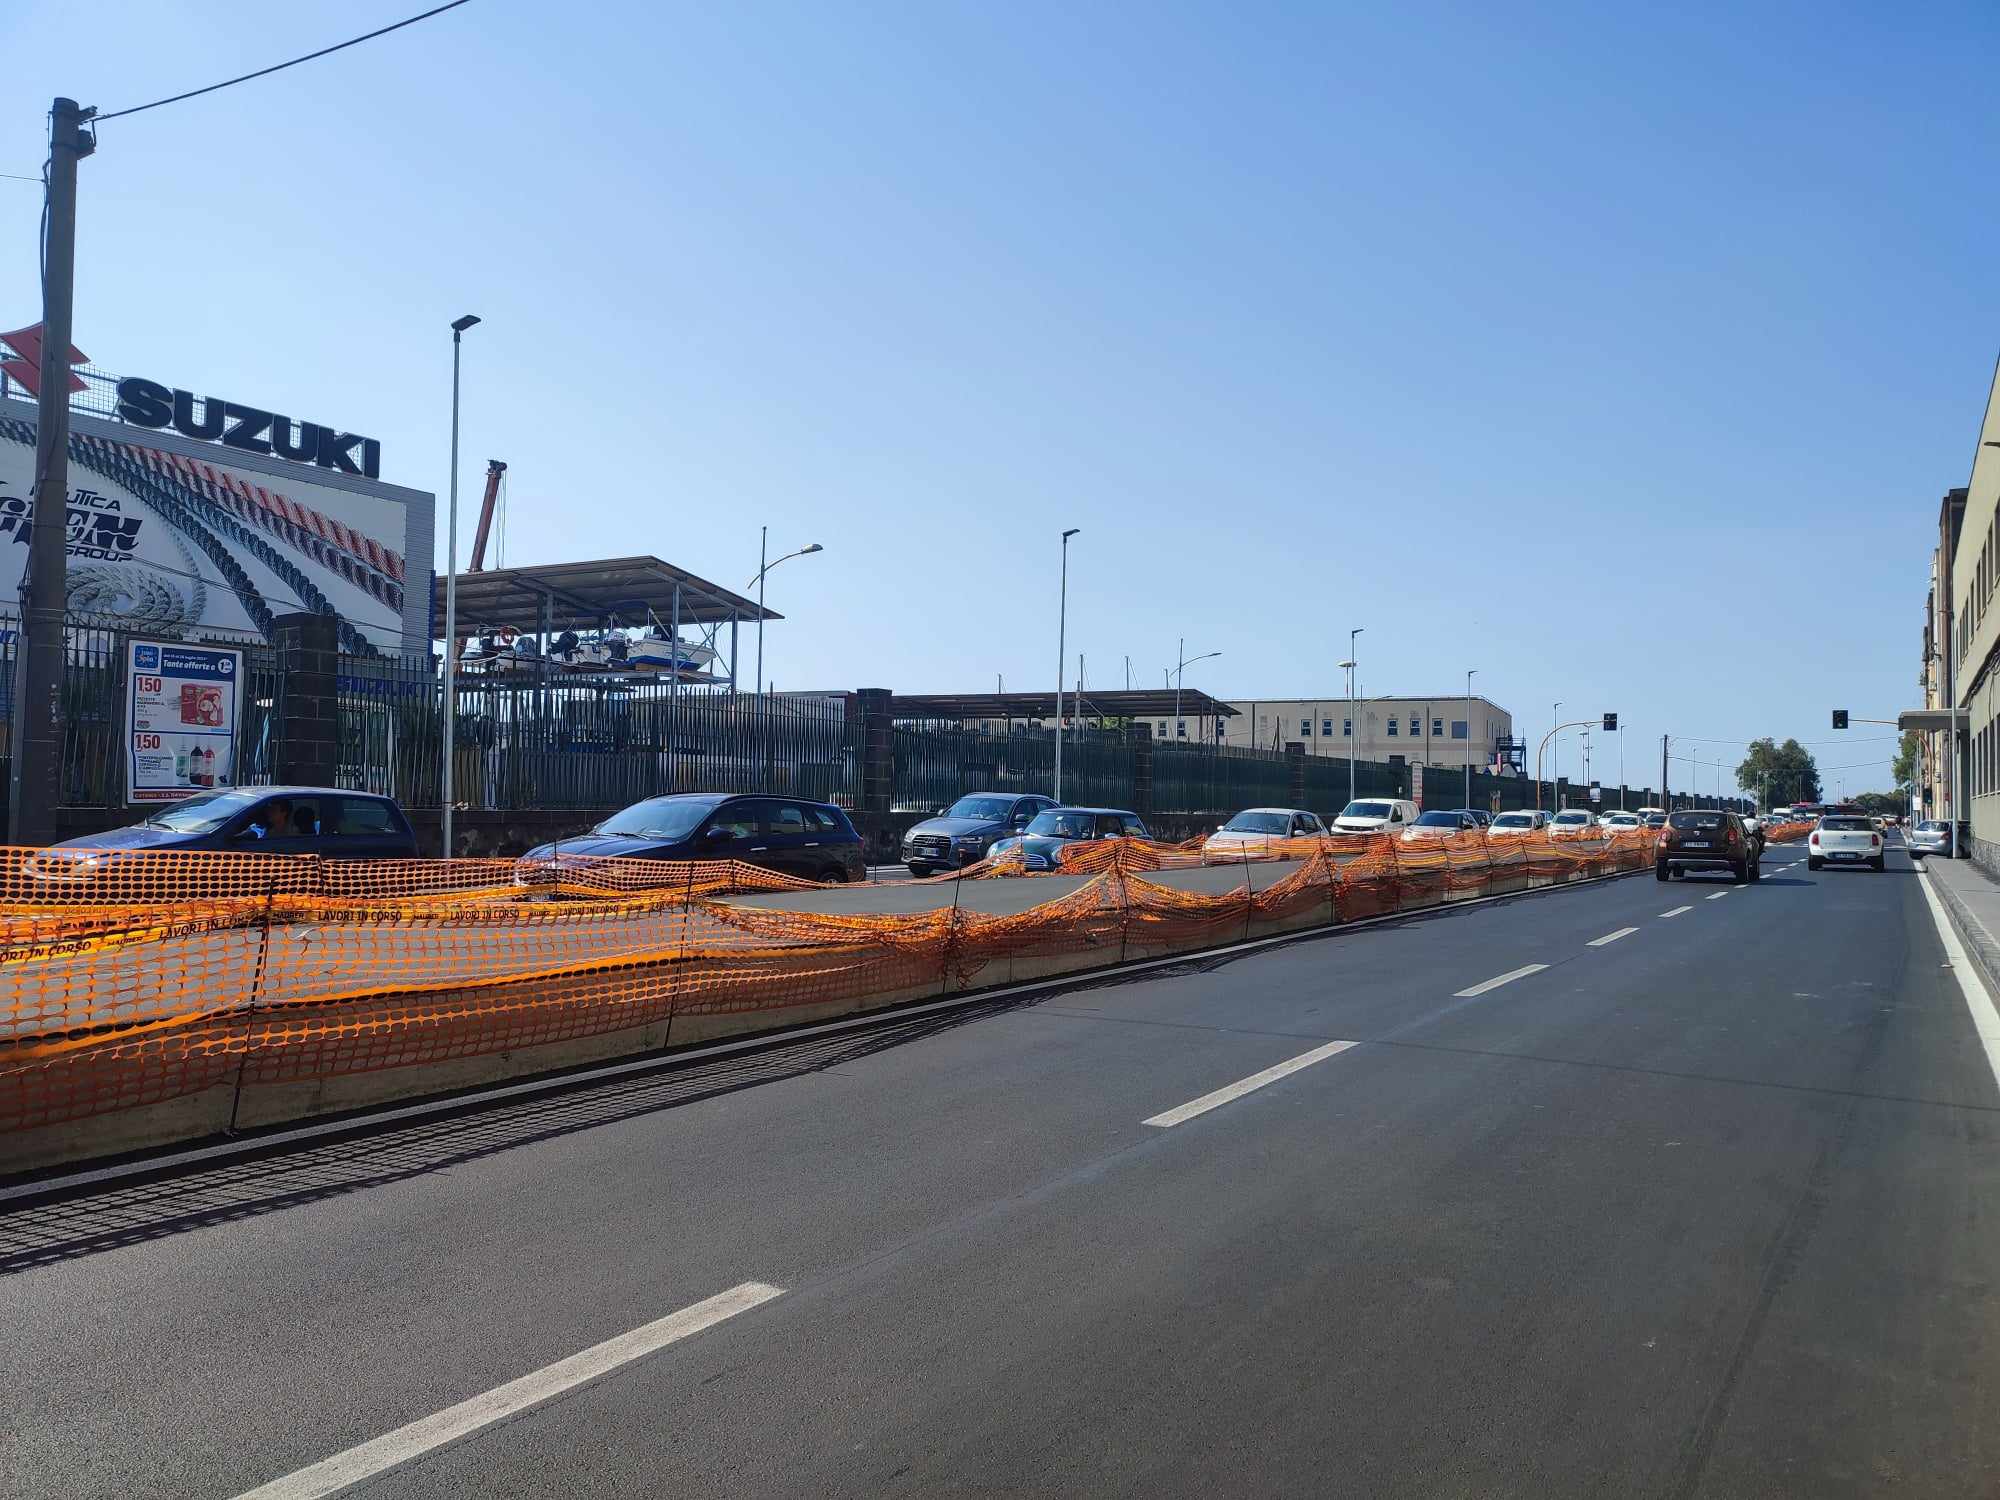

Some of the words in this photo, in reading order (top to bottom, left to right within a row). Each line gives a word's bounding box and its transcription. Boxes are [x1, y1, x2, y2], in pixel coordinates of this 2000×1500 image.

[116, 376, 381, 479] SUZUKI
[318, 910, 355, 922] LAVORI
[357, 911, 369, 922] IN
[371, 911, 402, 922] CORSO
[450, 910, 480, 921] LAVORI
[481, 909, 492, 920] IN
[493, 908, 520, 920] CORSO
[559, 906, 586, 917] LAVORI
[596, 904, 619, 914] CORSO
[159, 923, 204, 939] LAVORI
[29, 945, 44, 958] IN
[48, 941, 92, 958] CORSO
